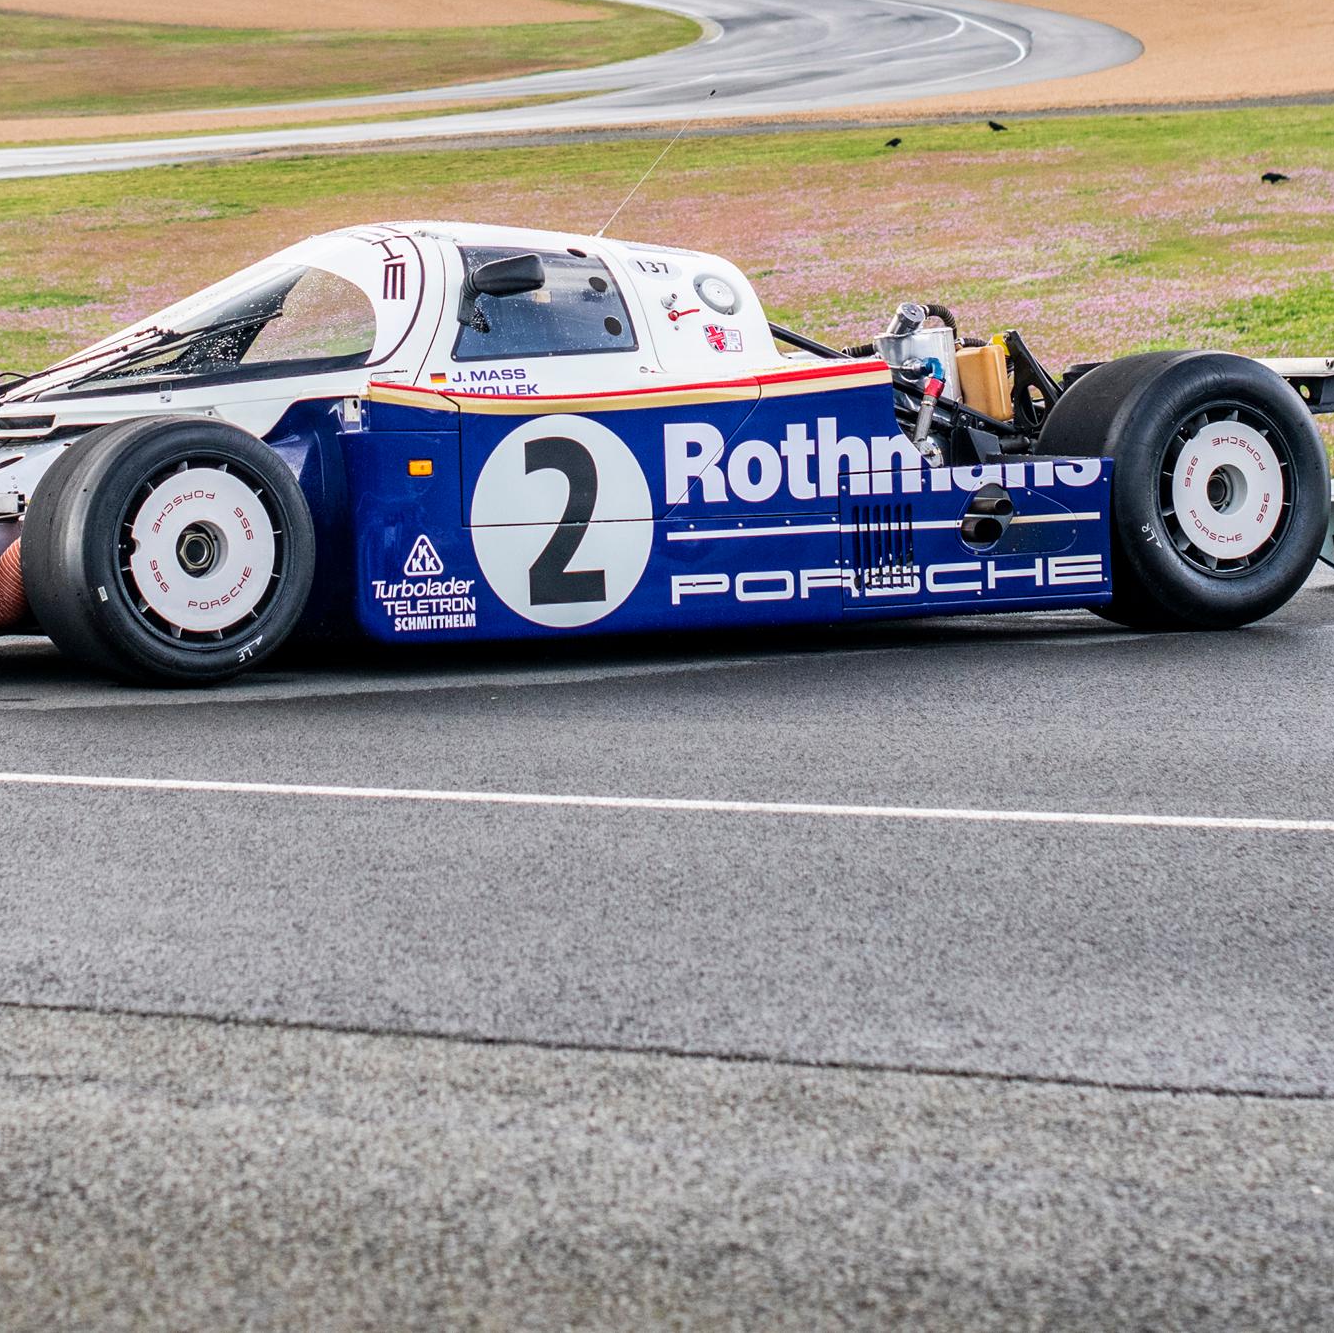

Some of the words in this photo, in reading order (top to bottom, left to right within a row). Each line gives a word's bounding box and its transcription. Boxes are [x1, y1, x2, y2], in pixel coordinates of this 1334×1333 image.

[636, 260, 669, 274] 137
[452, 371, 467, 383] J.
[470, 368, 527, 382] MASS
[1212, 436, 1266, 472] PORSCHE
[1184, 455, 1199, 488] 956
[152, 490, 216, 534] PORSCHE
[233, 507, 254, 541] 956
[524, 436, 607, 605] 2
[1256, 492, 1270, 524] 956
[1189, 509, 1243, 543] PORSCHE
[150, 560, 170, 593] 956
[188, 566, 252, 610] PORSCHE
[372, 577, 475, 599] Turbolader
[671, 554, 1103, 605] PORSCHE
[383, 597, 476, 616] TELETRON
[395, 613, 476, 632] SCHMITTHELM
